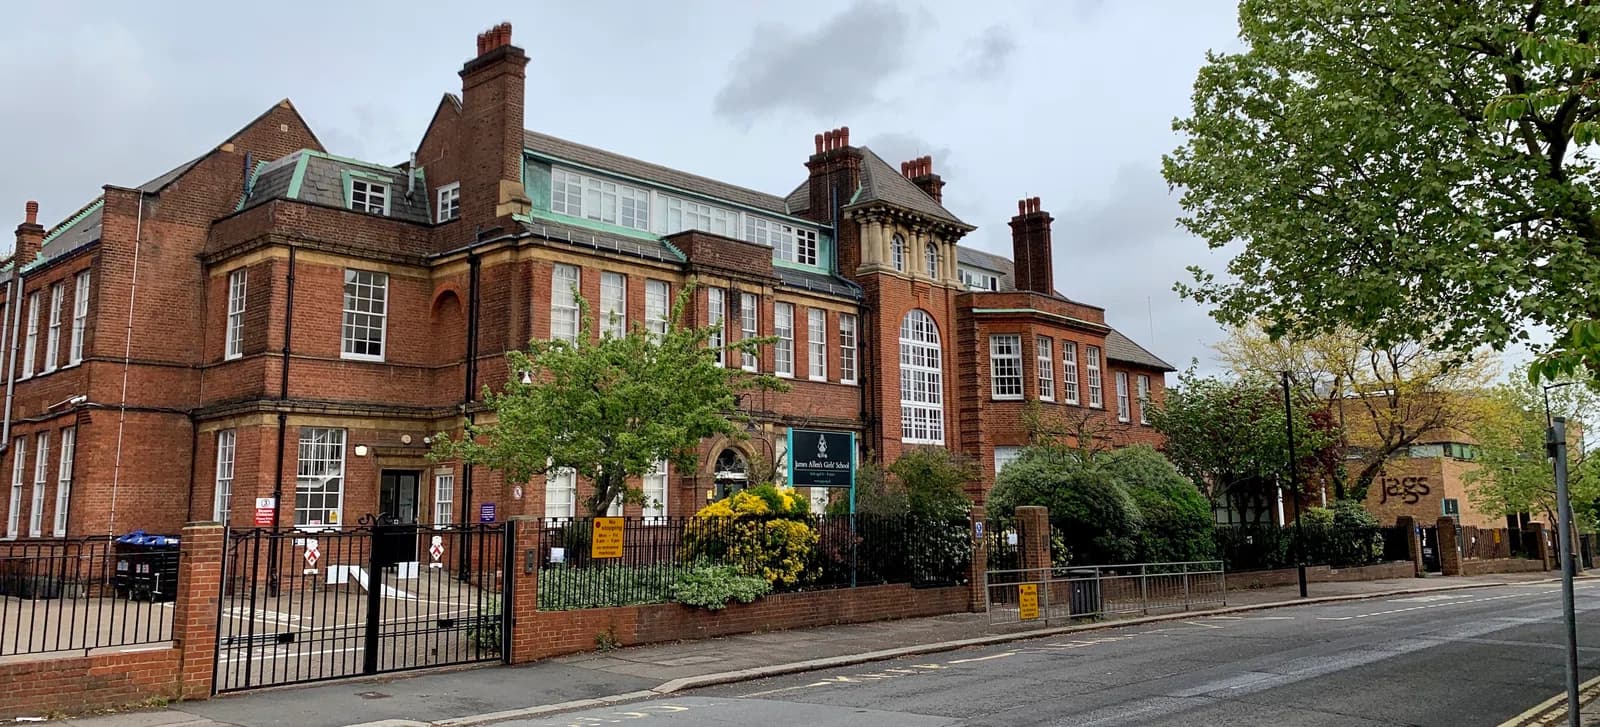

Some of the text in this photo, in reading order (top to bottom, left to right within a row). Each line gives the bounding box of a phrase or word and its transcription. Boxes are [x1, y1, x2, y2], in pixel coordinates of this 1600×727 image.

[795, 460, 808, 470] James
[809, 460, 823, 469] Allen's
[835, 461, 850, 470] School
[1380, 470, 1430, 504] jags
